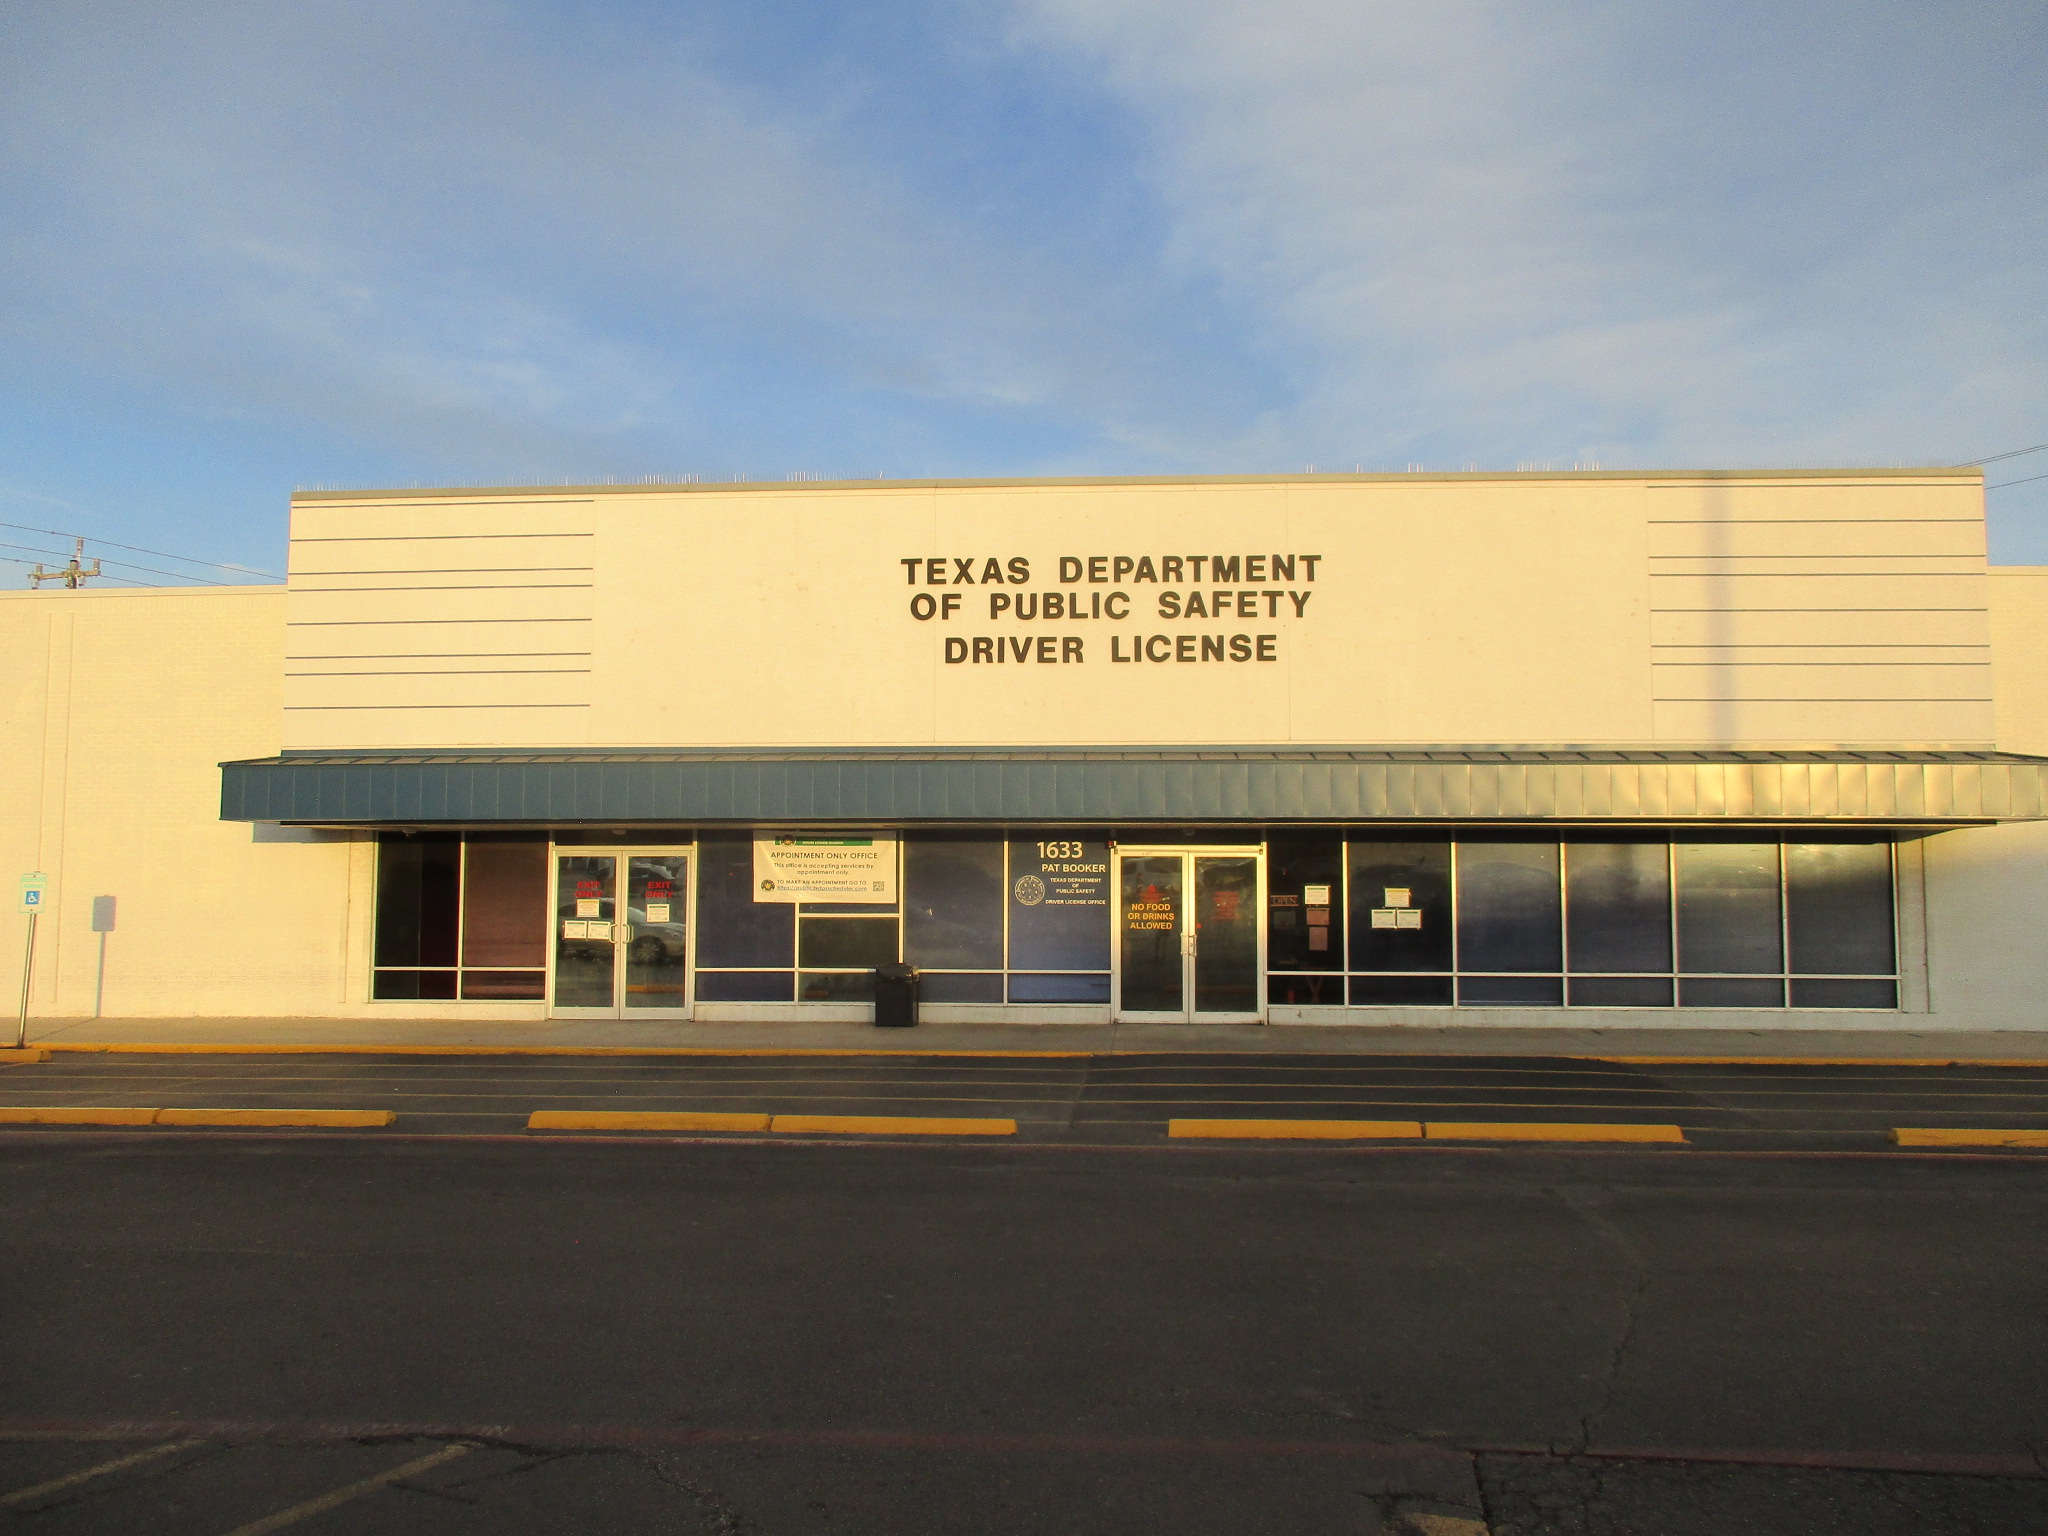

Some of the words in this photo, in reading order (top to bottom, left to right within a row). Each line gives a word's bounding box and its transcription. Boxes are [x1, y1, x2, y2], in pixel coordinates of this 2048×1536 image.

[900, 557, 1030, 585] TEXAS
[1059, 554, 1322, 584] DEPARTMENT
[910, 593, 962, 620] OF
[990, 591, 1131, 620] PUBLIC
[1158, 590, 1312, 618] SAFETY
[945, 636, 1084, 664] DRIVER
[1111, 634, 1277, 663] LICENSE
[1036, 841, 1083, 859] 1633
[850, 852, 878, 860] OFFICE
[1041, 863, 1060, 873] PAT
[1062, 864, 1106, 873] BOOKER
[577, 881, 601, 889] EXIT
[647, 881, 672, 889] EXIT
[575, 890, 603, 898] ONLY
[645, 890, 674, 898] ONLY
[1131, 903, 1145, 911] NO
[1146, 903, 1171, 911] FOOD
[1127, 912, 1140, 920] OR
[1142, 912, 1175, 920] DRINKS
[1129, 922, 1173, 930] ALLOWED
